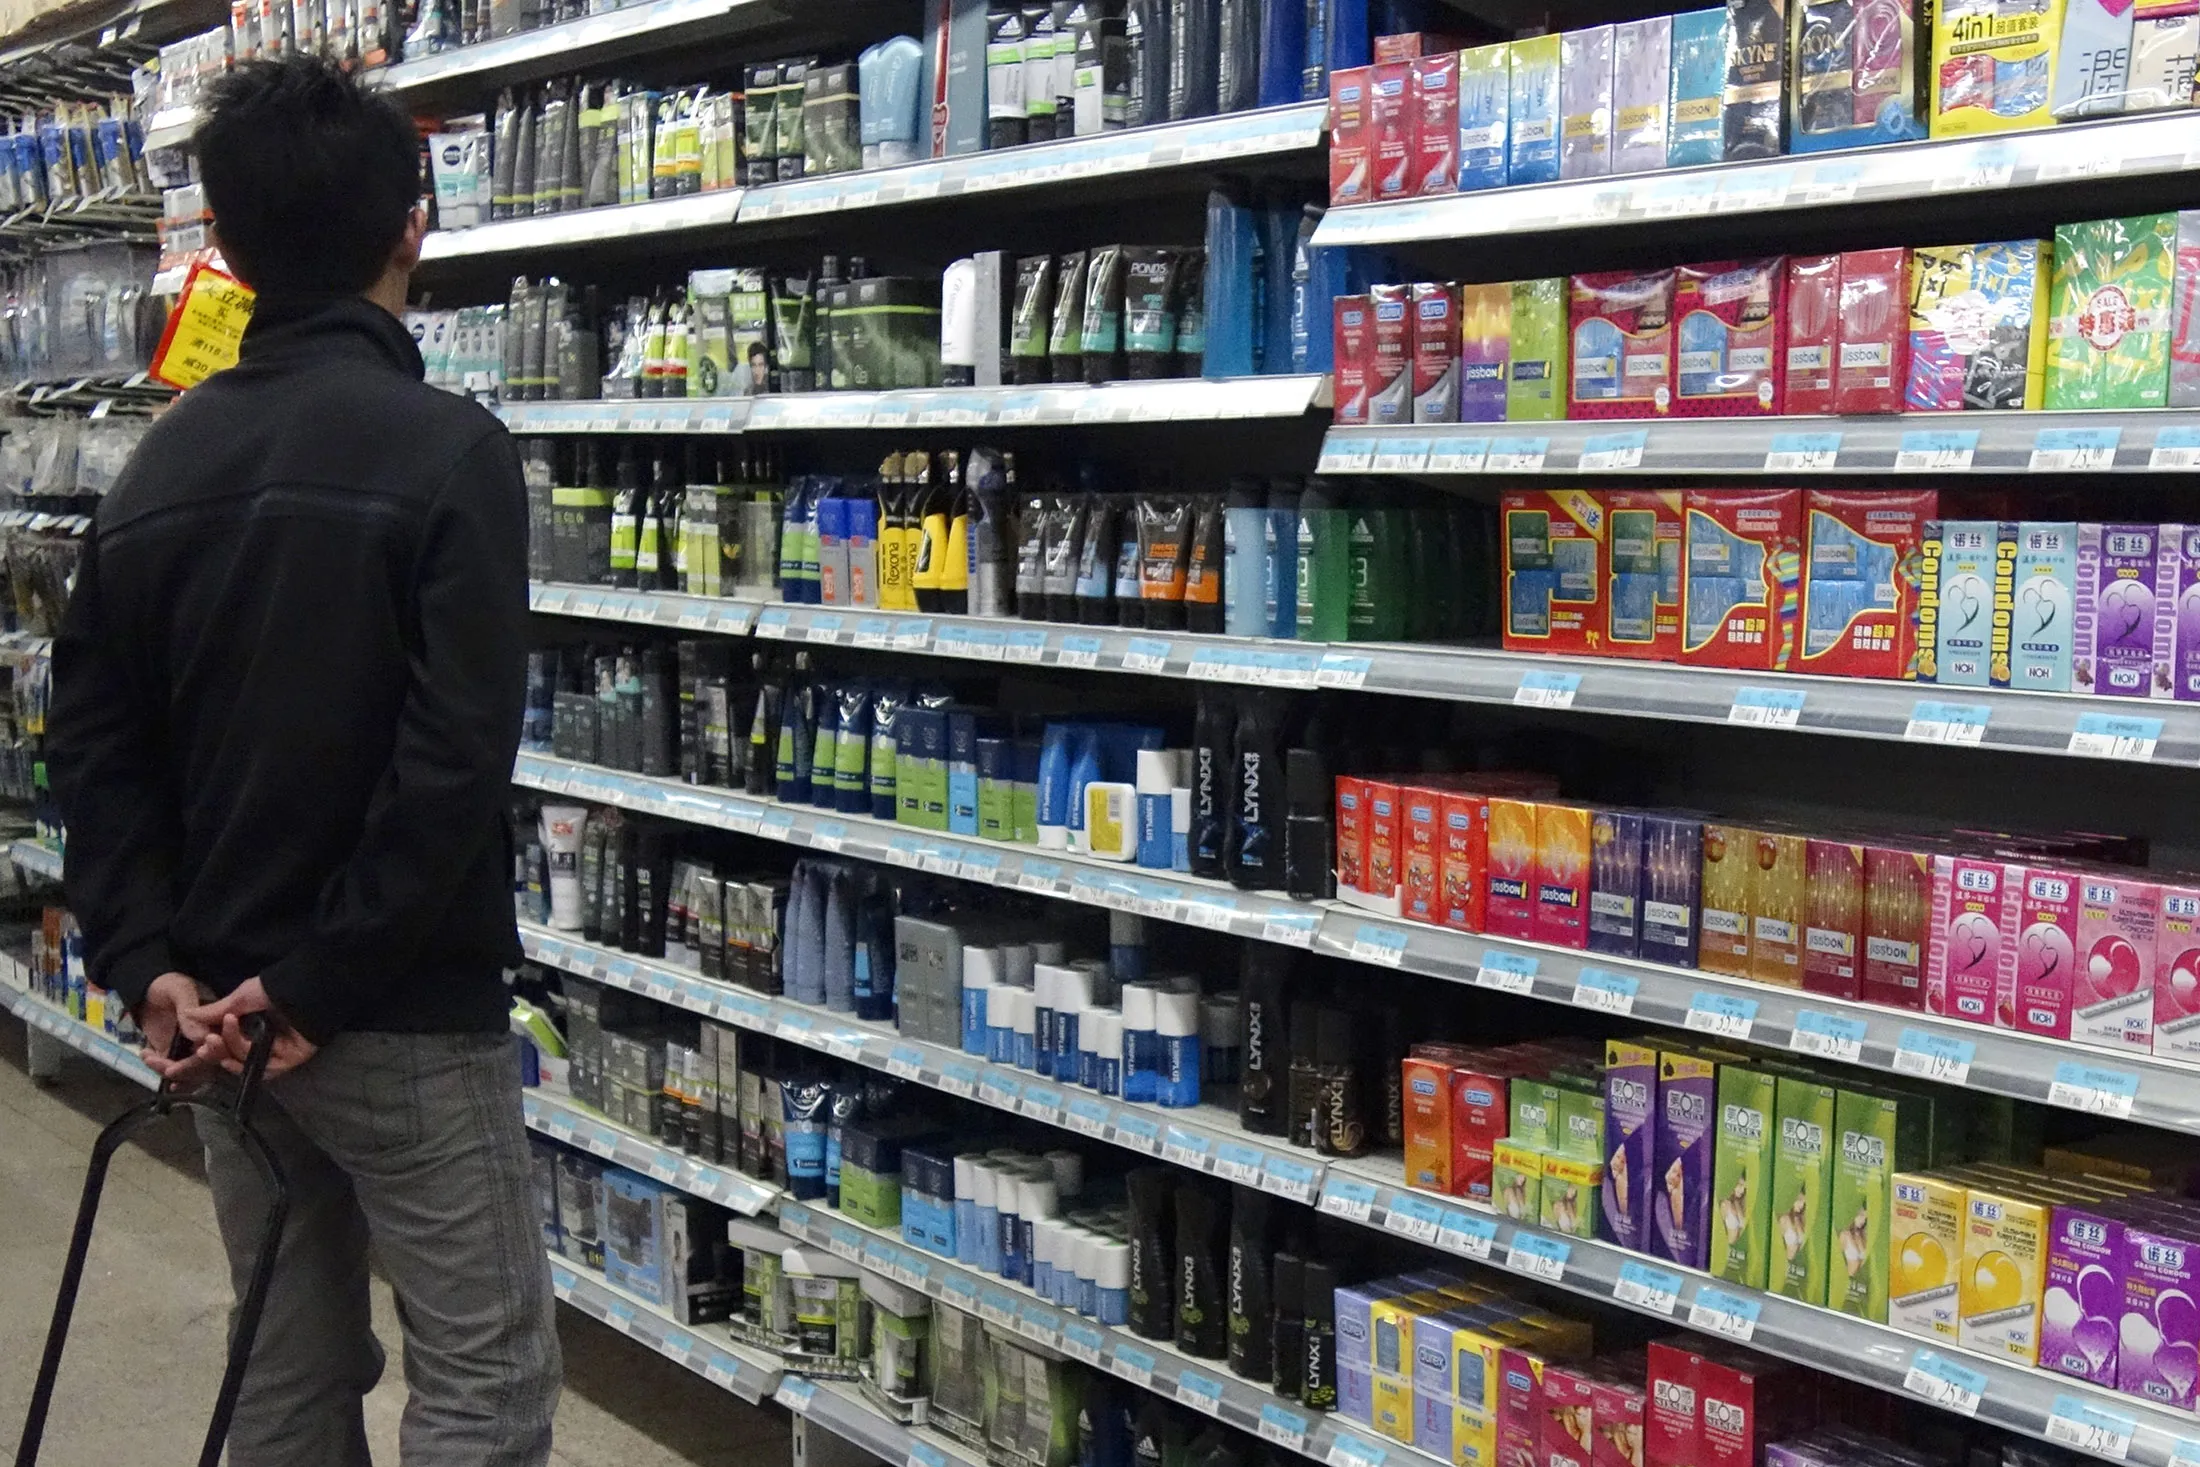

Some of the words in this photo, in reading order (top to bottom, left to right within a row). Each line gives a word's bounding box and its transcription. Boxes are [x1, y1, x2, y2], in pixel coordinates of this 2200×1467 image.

[1952, 16, 1994, 42] 4in1
[1954, 533, 1982, 548] 诺丝
[2030, 534, 2058, 549] 诺丝
[2112, 536, 2144, 551] 诺丝
[887, 542, 901, 587] Rexona
[1200, 754, 1212, 816] LYNX
[1244, 761, 1260, 823] LYNX
[1963, 872, 1990, 889] 诺丝
[2034, 880, 2063, 898] 诺丝
[2087, 887, 2112, 901] 诺丝
[2168, 898, 2195, 913] 诺丝
[1250, 1011, 1261, 1070] LYNX
[1331, 1088, 1344, 1143] LYNX
[1897, 1185, 1920, 1201] 诺丝
[1973, 1201, 1997, 1219] 诺丝
[2073, 1222, 2101, 1242] 诺丝
[2148, 1246, 2178, 1266] 诺丝
[1133, 1245, 1142, 1290] LYNX
[1185, 1262, 1195, 1309] LYNX
[1232, 1253, 1243, 1314] LYNX
[1309, 1344, 1321, 1388] LYNX
